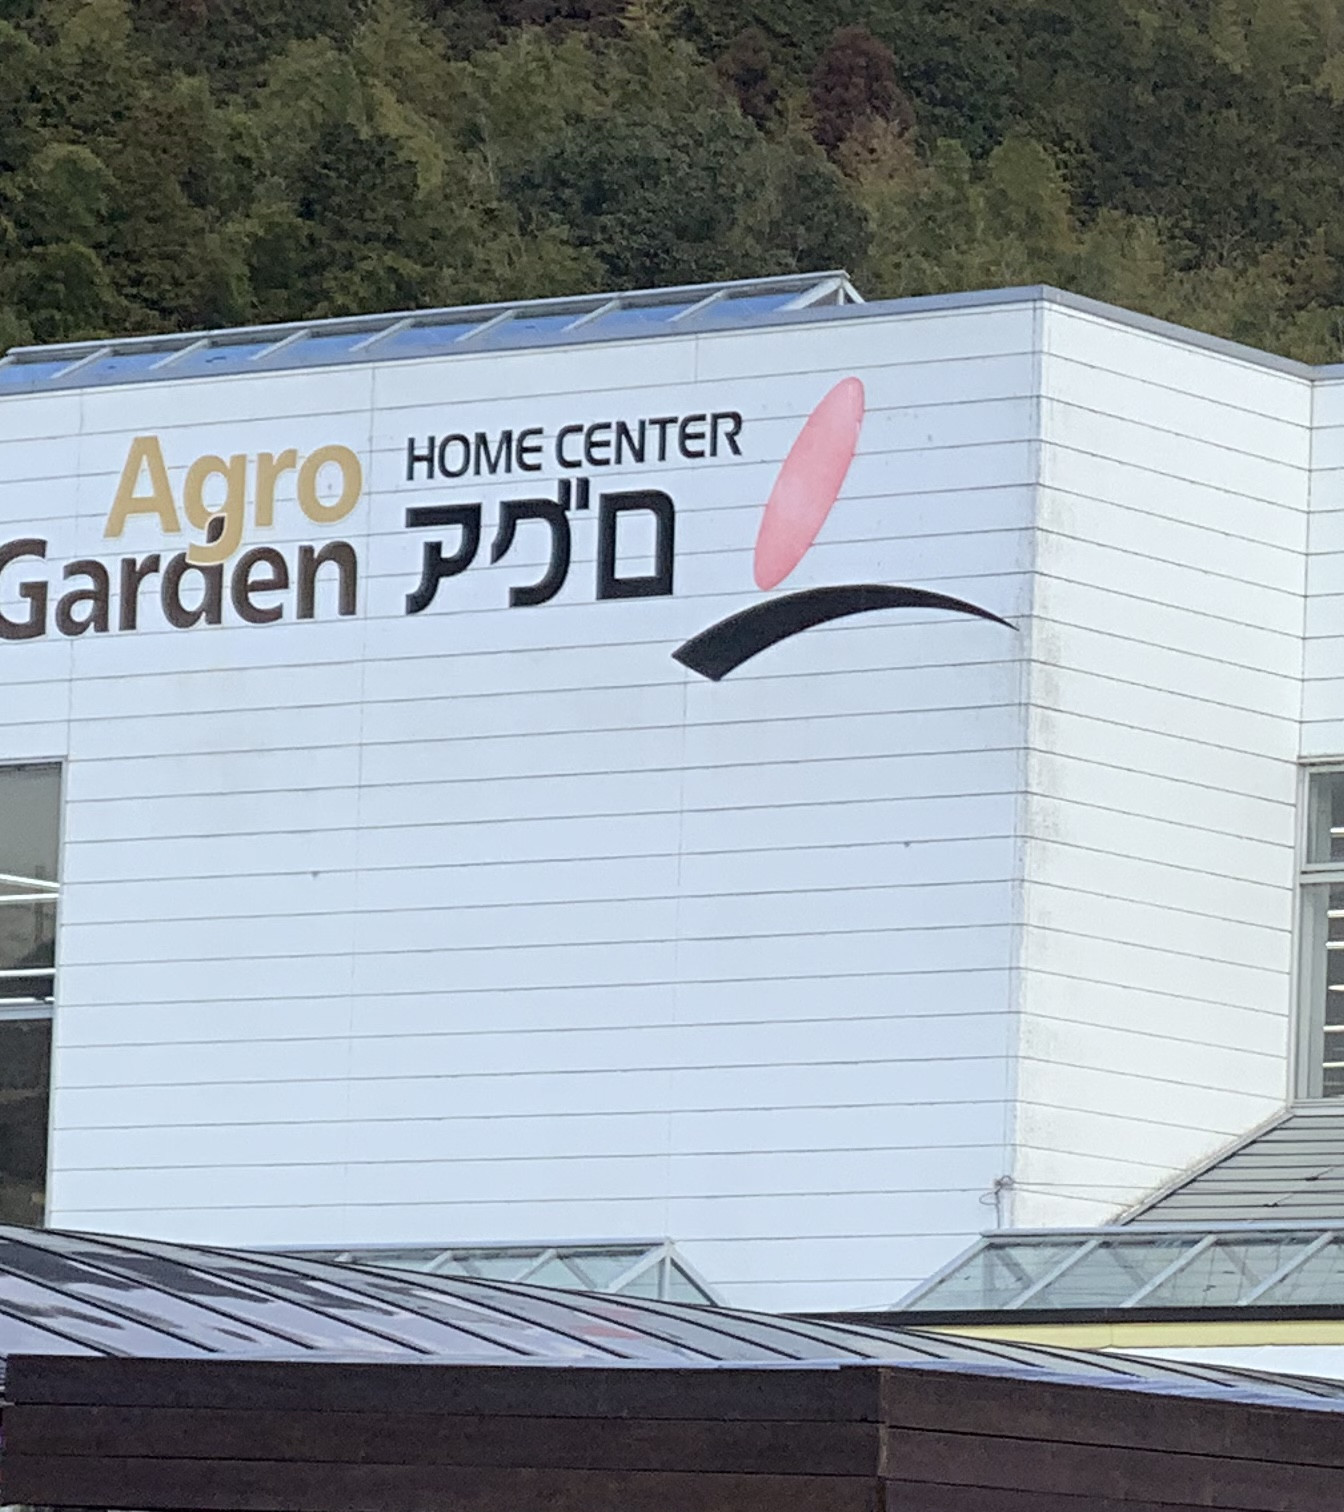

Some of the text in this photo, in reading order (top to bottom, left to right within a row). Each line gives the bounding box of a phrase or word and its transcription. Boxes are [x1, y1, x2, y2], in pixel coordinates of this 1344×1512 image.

[103, 434, 363, 564] Agro
[406, 410, 743, 482] HOME CENTER
[0, 514, 359, 642] Garden
[405, 477, 676, 615] アグロ
